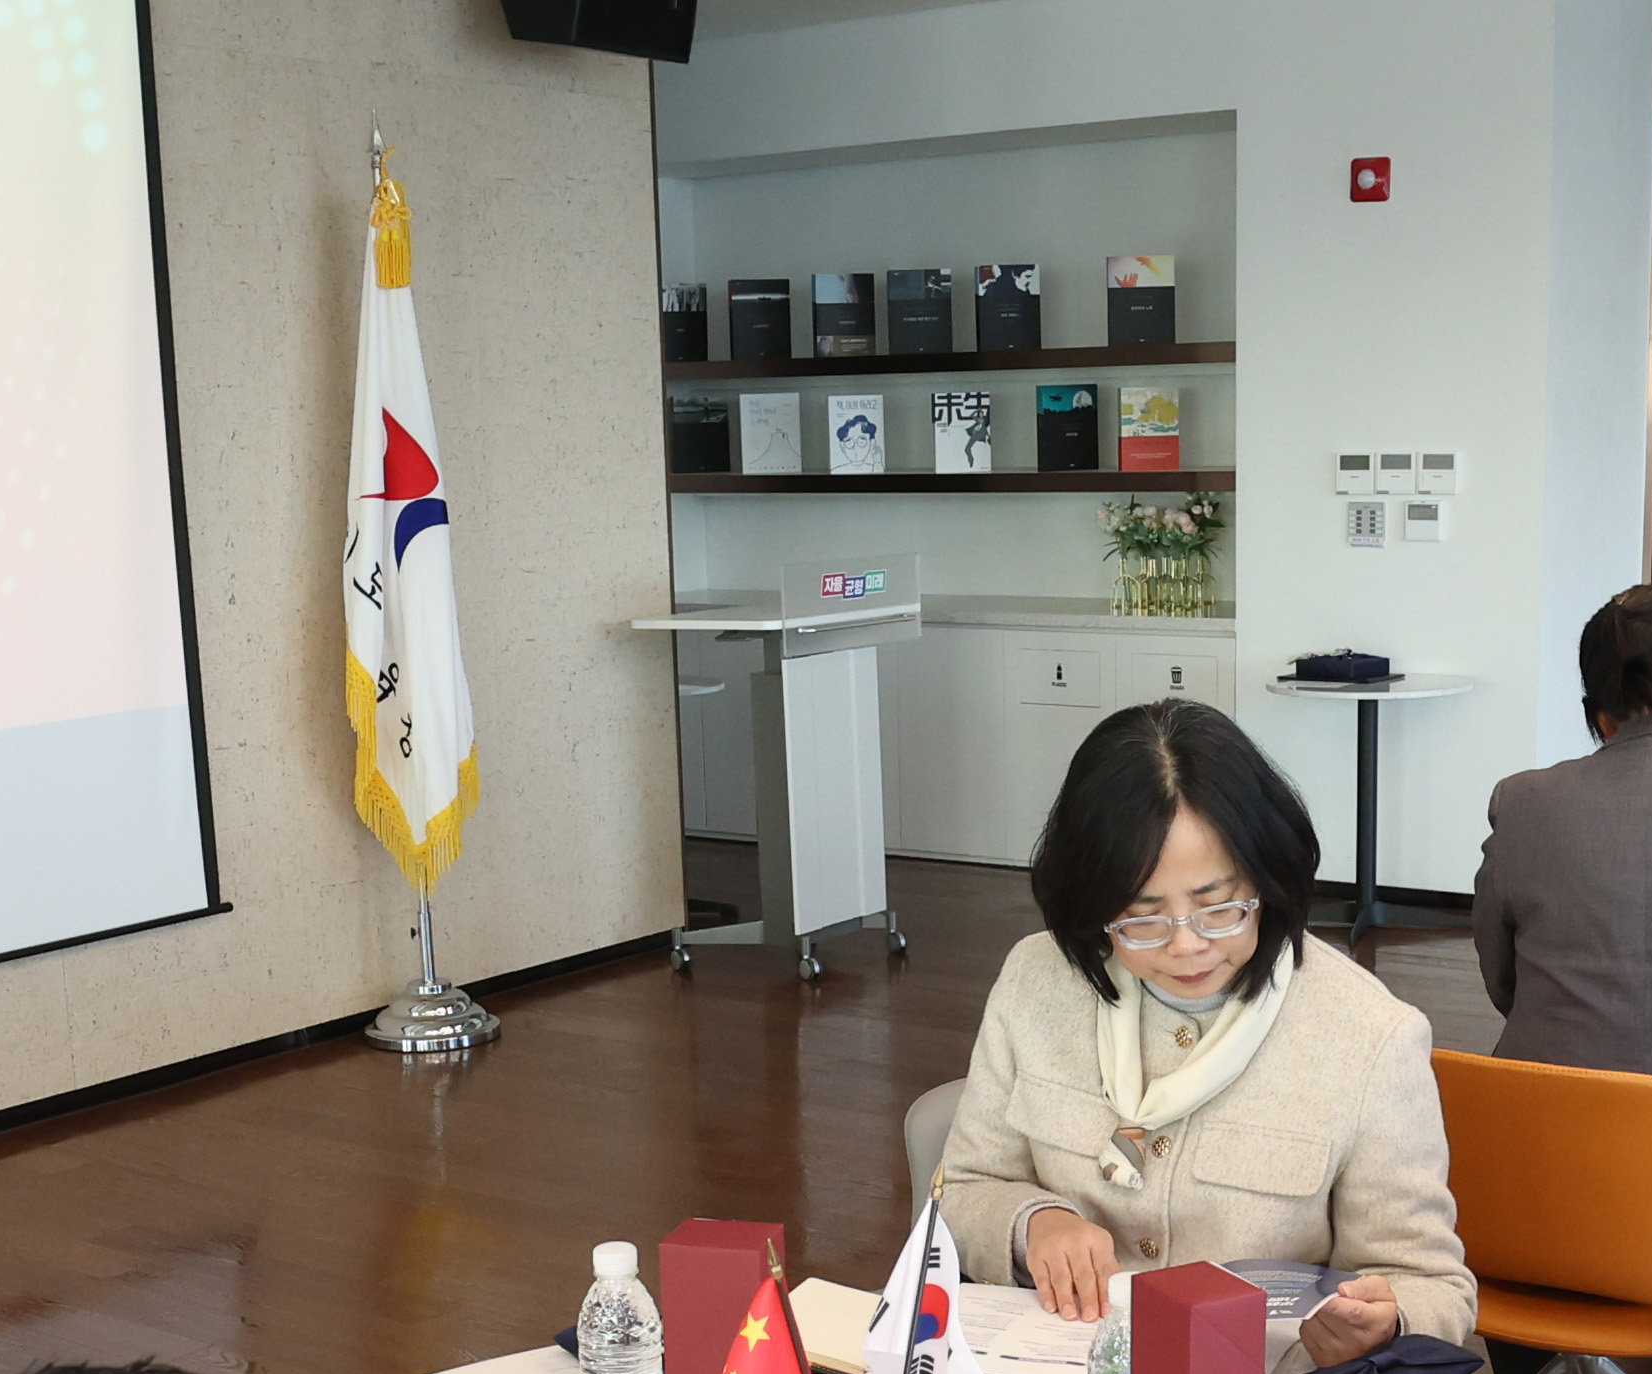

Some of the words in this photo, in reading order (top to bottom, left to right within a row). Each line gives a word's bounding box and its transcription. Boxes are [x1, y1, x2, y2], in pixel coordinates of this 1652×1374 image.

[824, 575, 844, 593] 자율
[845, 578, 864, 597] 균형
[865, 573, 885, 590] 미래
